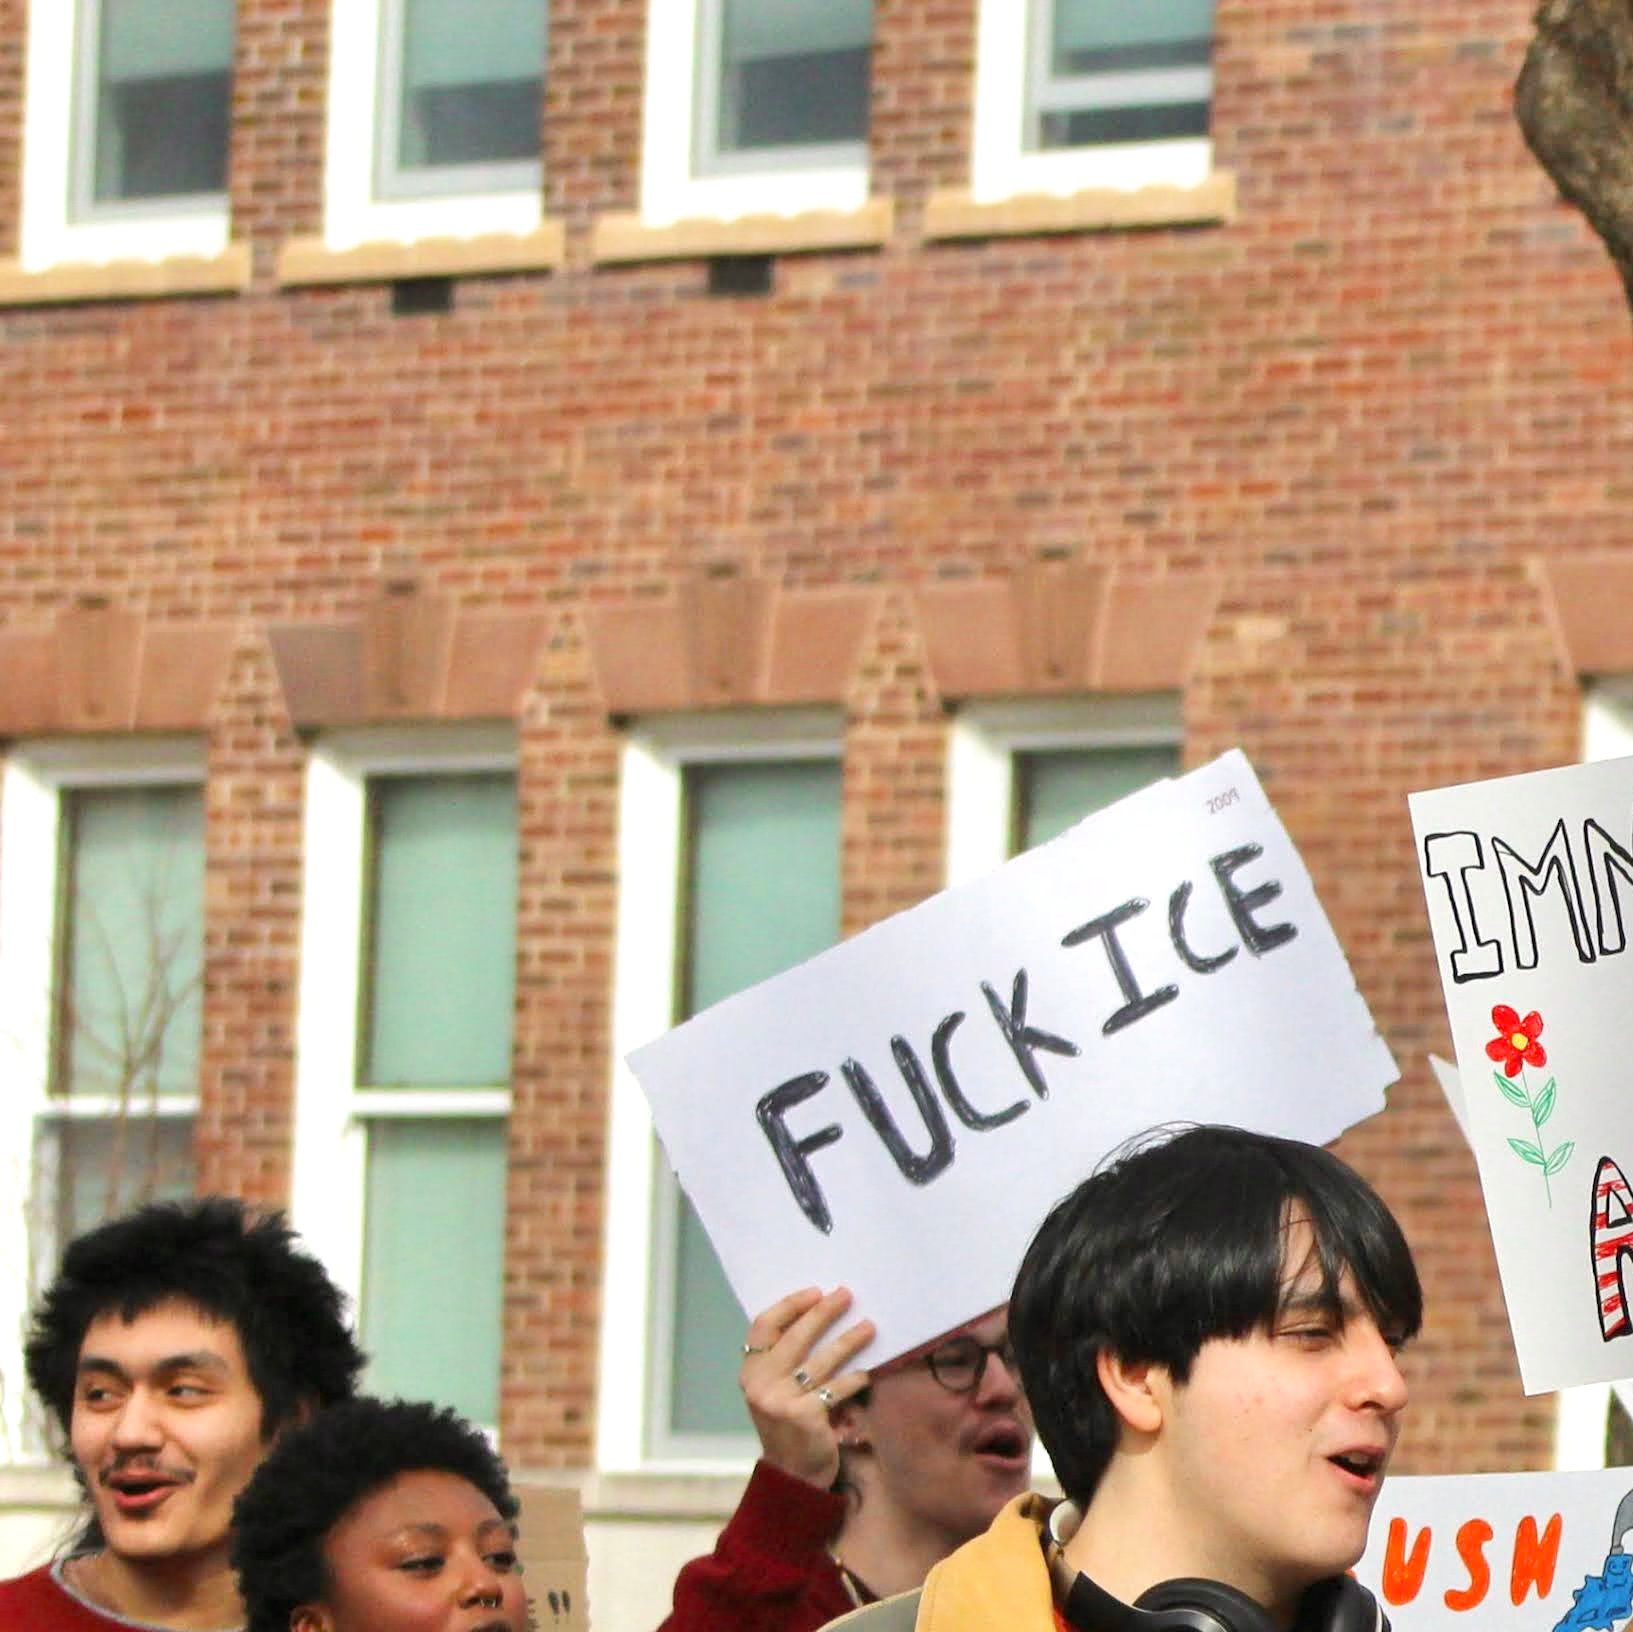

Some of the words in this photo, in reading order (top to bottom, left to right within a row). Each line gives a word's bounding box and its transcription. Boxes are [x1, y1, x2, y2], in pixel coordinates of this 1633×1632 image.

[755, 967, 1078, 1236] FUCK
[1061, 842, 1299, 1037] ICE
[1344, 1513, 1562, 1611] USH
